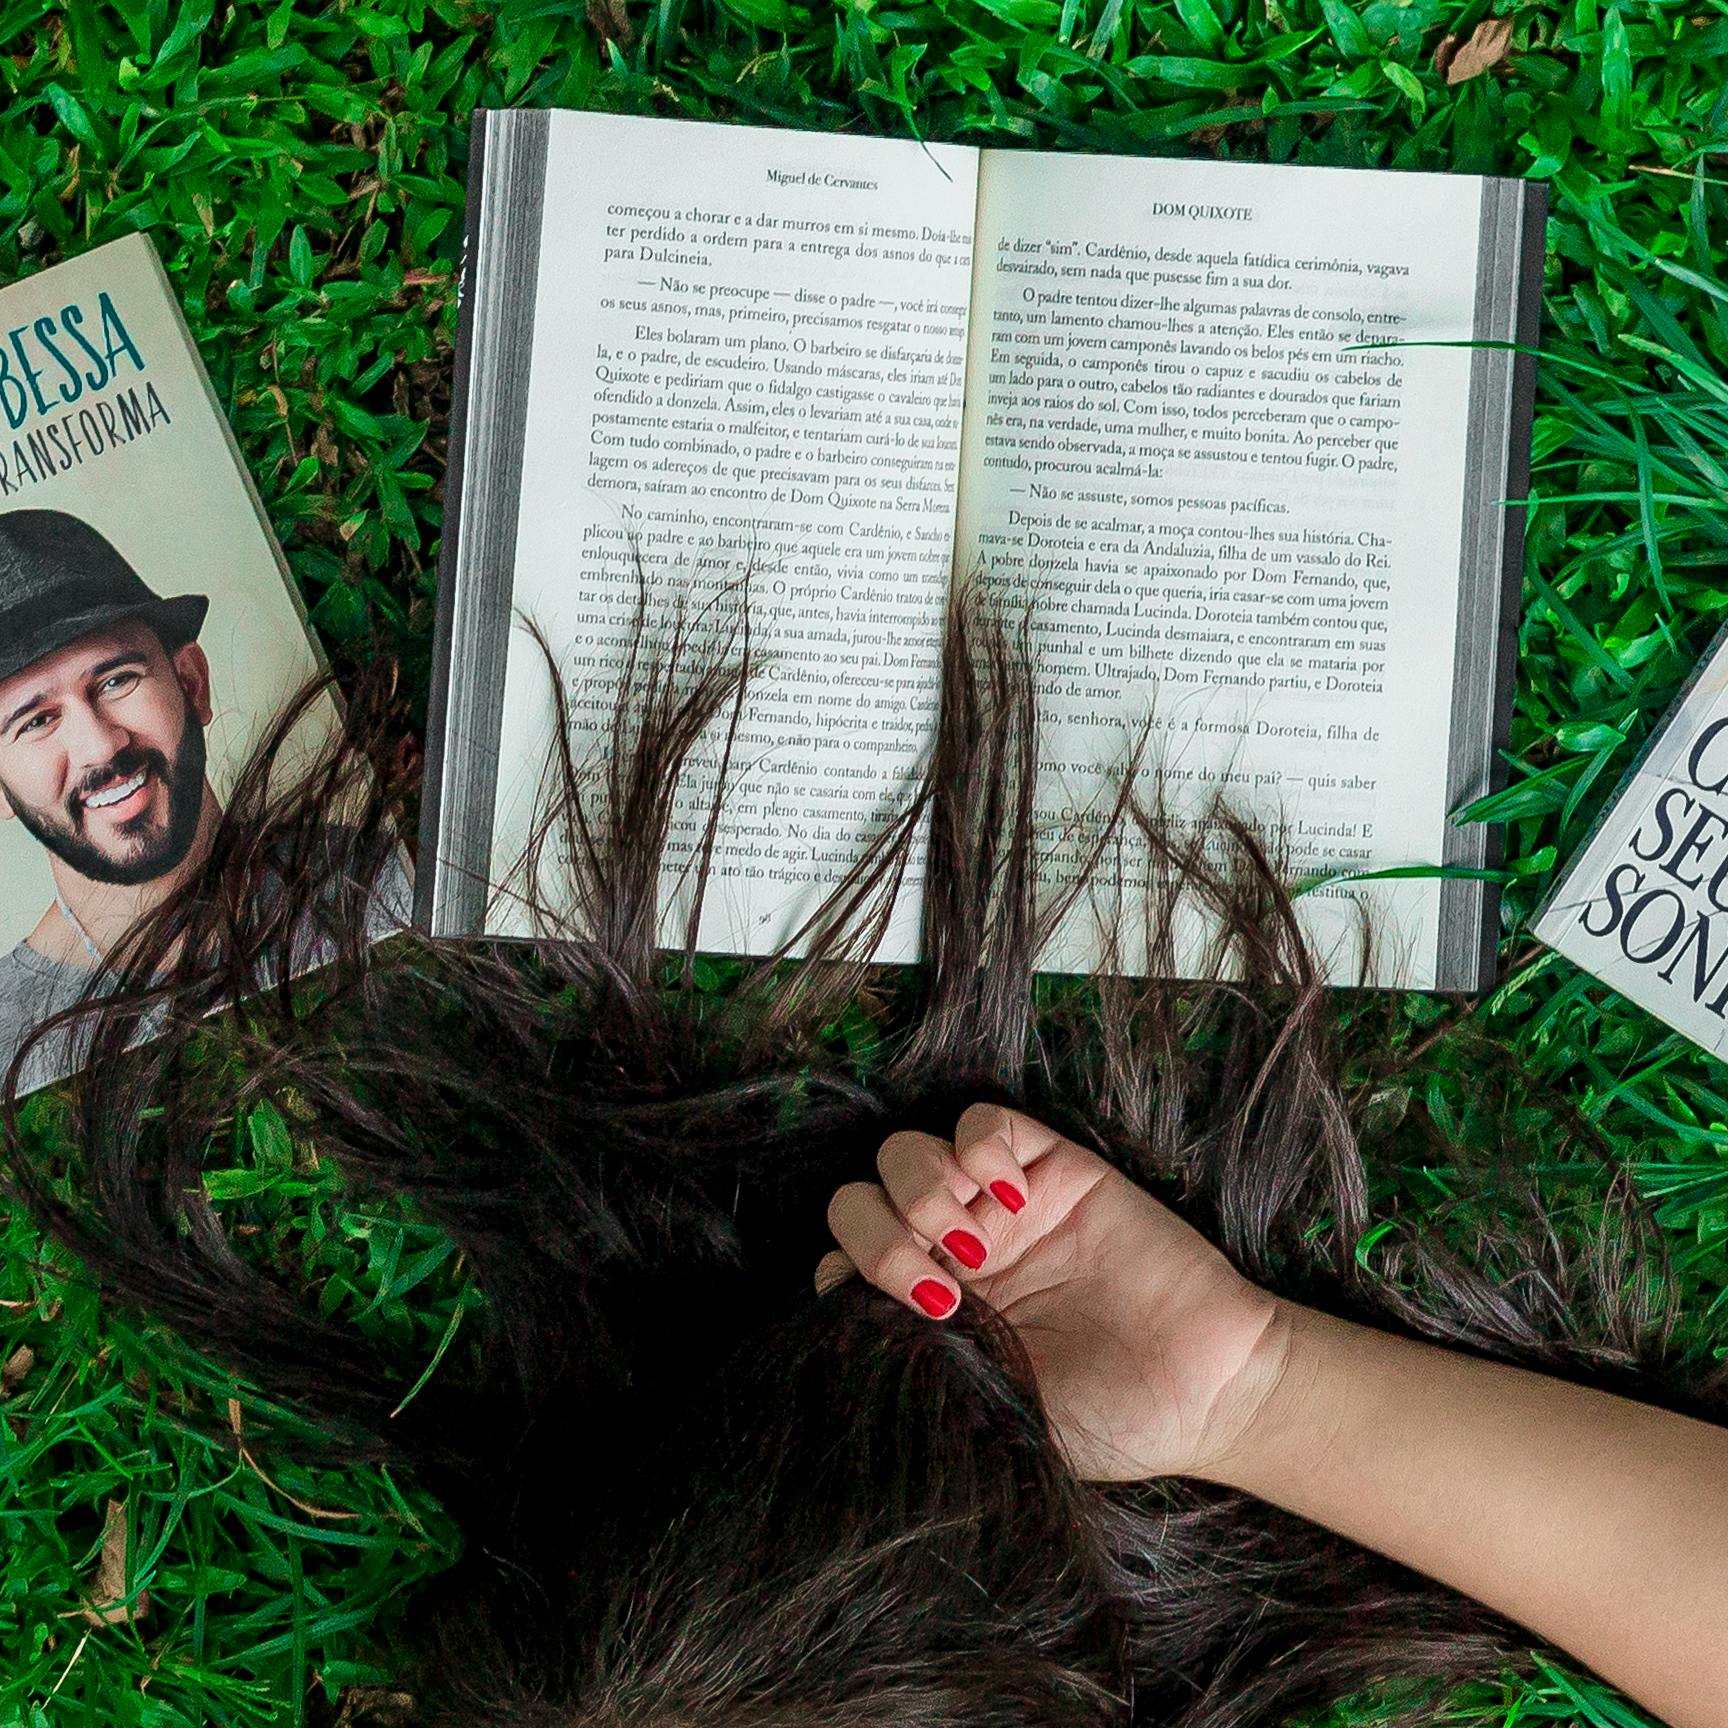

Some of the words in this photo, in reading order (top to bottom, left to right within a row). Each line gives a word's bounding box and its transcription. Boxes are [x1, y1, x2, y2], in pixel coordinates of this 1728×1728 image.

[765, 168, 807, 188] Miguel
[807, 172, 822, 187] de
[823, 173, 879, 191] Cervantes
[607, 204, 671, 222] começou
[673, 209, 683, 222] a
[684, 208, 732, 225] chorar
[733, 215, 742, 226] e
[744, 216, 753, 227] a
[755, 214, 780, 229] dar
[781, 219, 831, 234] murros
[833, 223, 855, 236] em
[857, 225, 869, 237] si
[871, 226, 919, 241] mesmo.
[1152, 202, 1187, 218] DOM
[1187, 204, 1253, 222] QUIXOTE
[603, 247, 635, 263] para
[639, 248, 713, 267] Dulcineia.
[606, 224, 627, 238] ter
[629, 227, 686, 244] perdido
[689, 232, 698, 244] a
[702, 232, 748, 248] ordem
[752, 238, 783, 253] para
[787, 241, 796, 252] a
[800, 242, 851, 260] entrega
[855, 244, 879, 259] dos
[882, 248, 916, 262] asnos
[918, 249, 933, 263] do
[997, 238, 1012, 254] de
[1012, 239, 1043, 254] dizer
[1084, 243, 1151, 265] Cardênio,
[1153, 248, 1193, 264] desde
[1195, 252, 1239, 269] aquela
[1242, 253, 1291, 270] fatídica
[1294, 259, 1364, 277] cerimônia,
[1366, 263, 1410, 280] vagava
[995, 259, 1059, 279] desvairado,
[1059, 265, 1087, 279] sem
[1089, 266, 1122, 281] nada
[1124, 270, 1150, 285] que
[1152, 271, 1203, 287] pusesse
[1205, 272, 1229, 287] fim
[1231, 276, 1240, 288] a
[1242, 277, 1265, 289] sua
[1266, 276, 1293, 291] dor.
[634, 327, 664, 343] Eles
[666, 329, 721, 348] bolaram
[724, 336, 747, 349] um
[749, 336, 790, 354] plano.
[792, 339, 807, 354] O
[810, 340, 863, 358] barbeiro
[864, 348, 878, 360] se
[879, 346, 933, 367] disfarçaria
[990, 349, 1011, 365] Em
[1013, 351, 1064, 370] seguida,
[1065, 356, 1078, 369] o
[1081, 358, 1149, 375] camponês
[1153, 360, 1186, 376] tirou
[1190, 365, 1201, 376] o
[1204, 366, 1245, 382] capuz
[1248, 369, 1256, 380] e
[1260, 368, 1310, 383] sacudiu
[1314, 372, 1330, 384] os
[1333, 371, 1382, 388] cabelos
[1386, 374, 1403, 389] de
[586, 474, 642, 495] demora,
[643, 479, 688, 495] saíram
[690, 485, 707, 497] ao
[709, 487, 768, 502] encontro
[769, 488, 787, 506] de
[789, 489, 824, 506] Dom
[827, 492, 877, 511] Quixote
[879, 500, 893, 511] na
[895, 497, 921, 513] Serra
